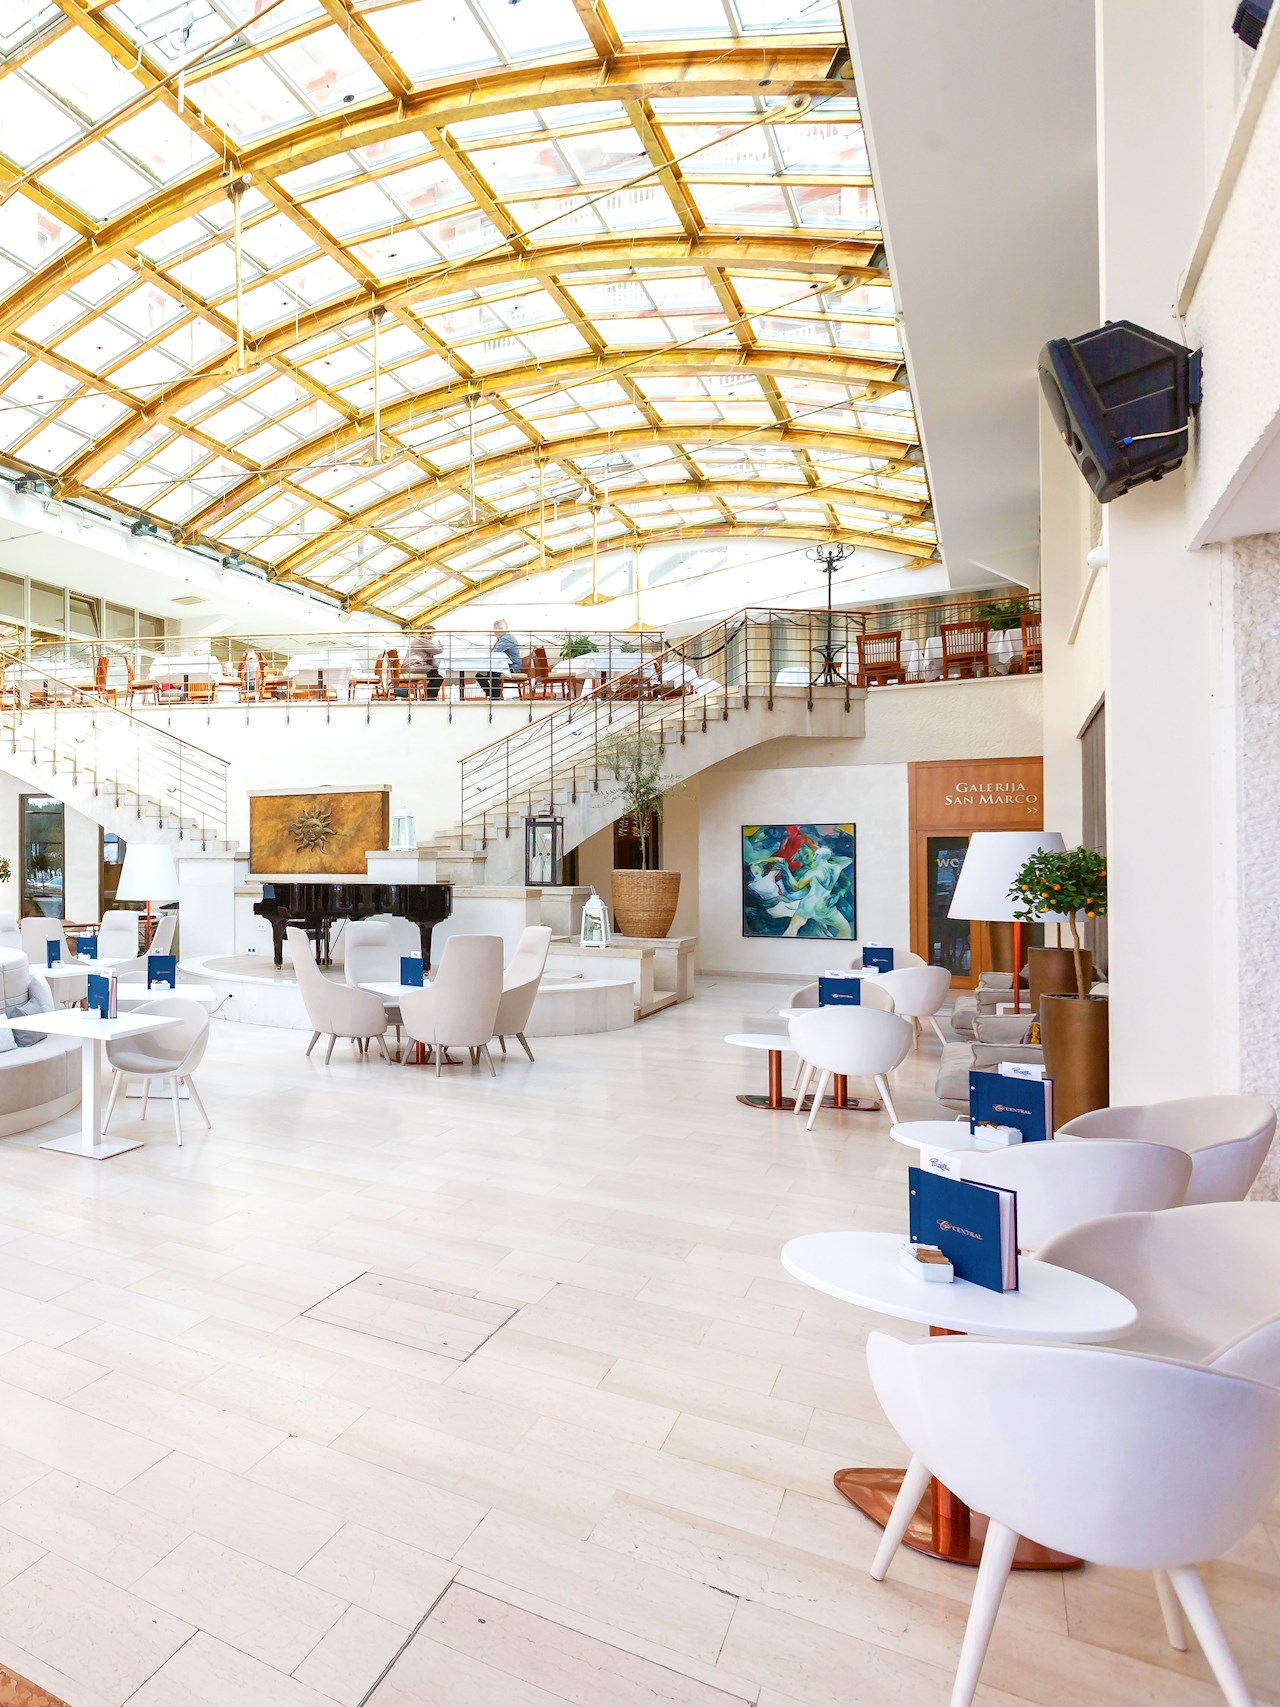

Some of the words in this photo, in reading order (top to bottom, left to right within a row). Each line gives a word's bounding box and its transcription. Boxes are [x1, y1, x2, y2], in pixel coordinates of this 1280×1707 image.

[955, 782, 1026, 793] GALERIJA
[945, 794, 974, 805] SAN
[979, 794, 1038, 804] MARCO
[936, 858, 959, 867] WC
[952, 1225, 983, 1240] CENTRAL
